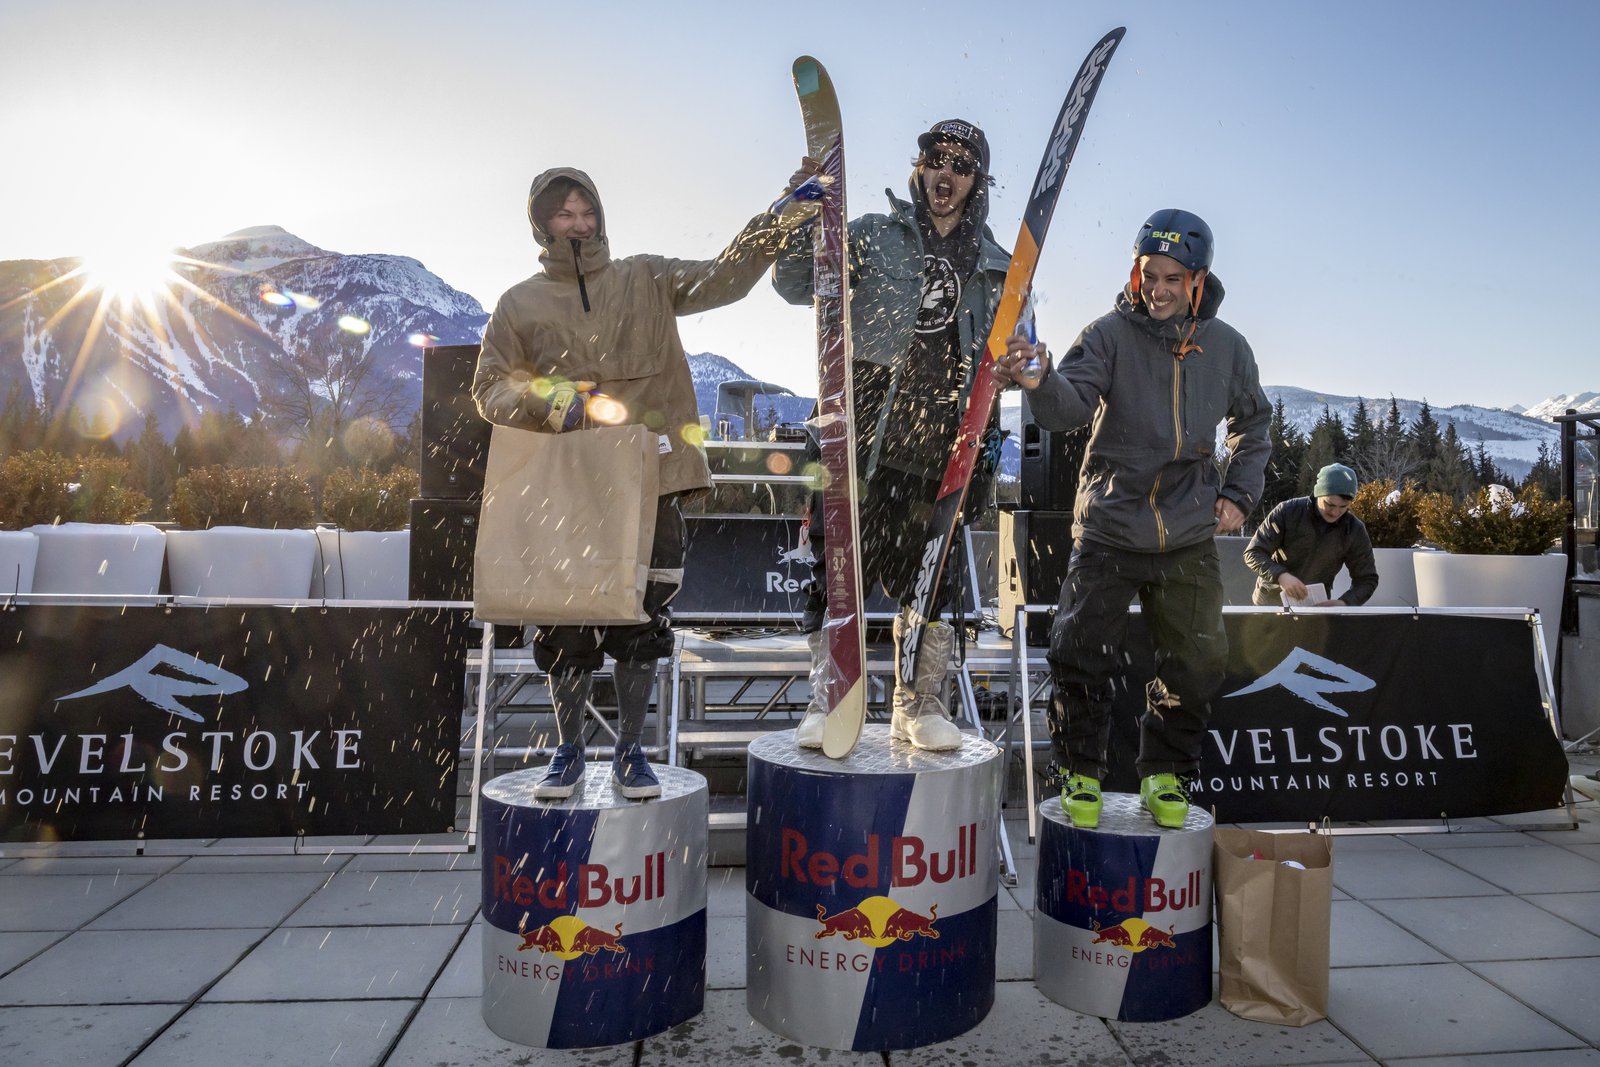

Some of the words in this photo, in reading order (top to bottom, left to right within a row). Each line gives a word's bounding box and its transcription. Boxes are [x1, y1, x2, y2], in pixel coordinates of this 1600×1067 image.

[1208, 723, 1478, 765] VELSTOKE
[190, 783, 307, 801] RESORT
[1189, 774, 1331, 792] MOUNTAIN
[1347, 771, 1437, 788] RESORT
[780, 827, 880, 888] Red
[891, 822, 977, 888] Bull
[494, 855, 567, 909] Red
[578, 851, 666, 909] Bull
[1066, 868, 1136, 913] Red
[1143, 869, 1200, 913] Bull
[498, 954, 574, 983] ENERGY
[786, 944, 887, 973] ENERGY
[1071, 946, 1141, 969] ENERGY
